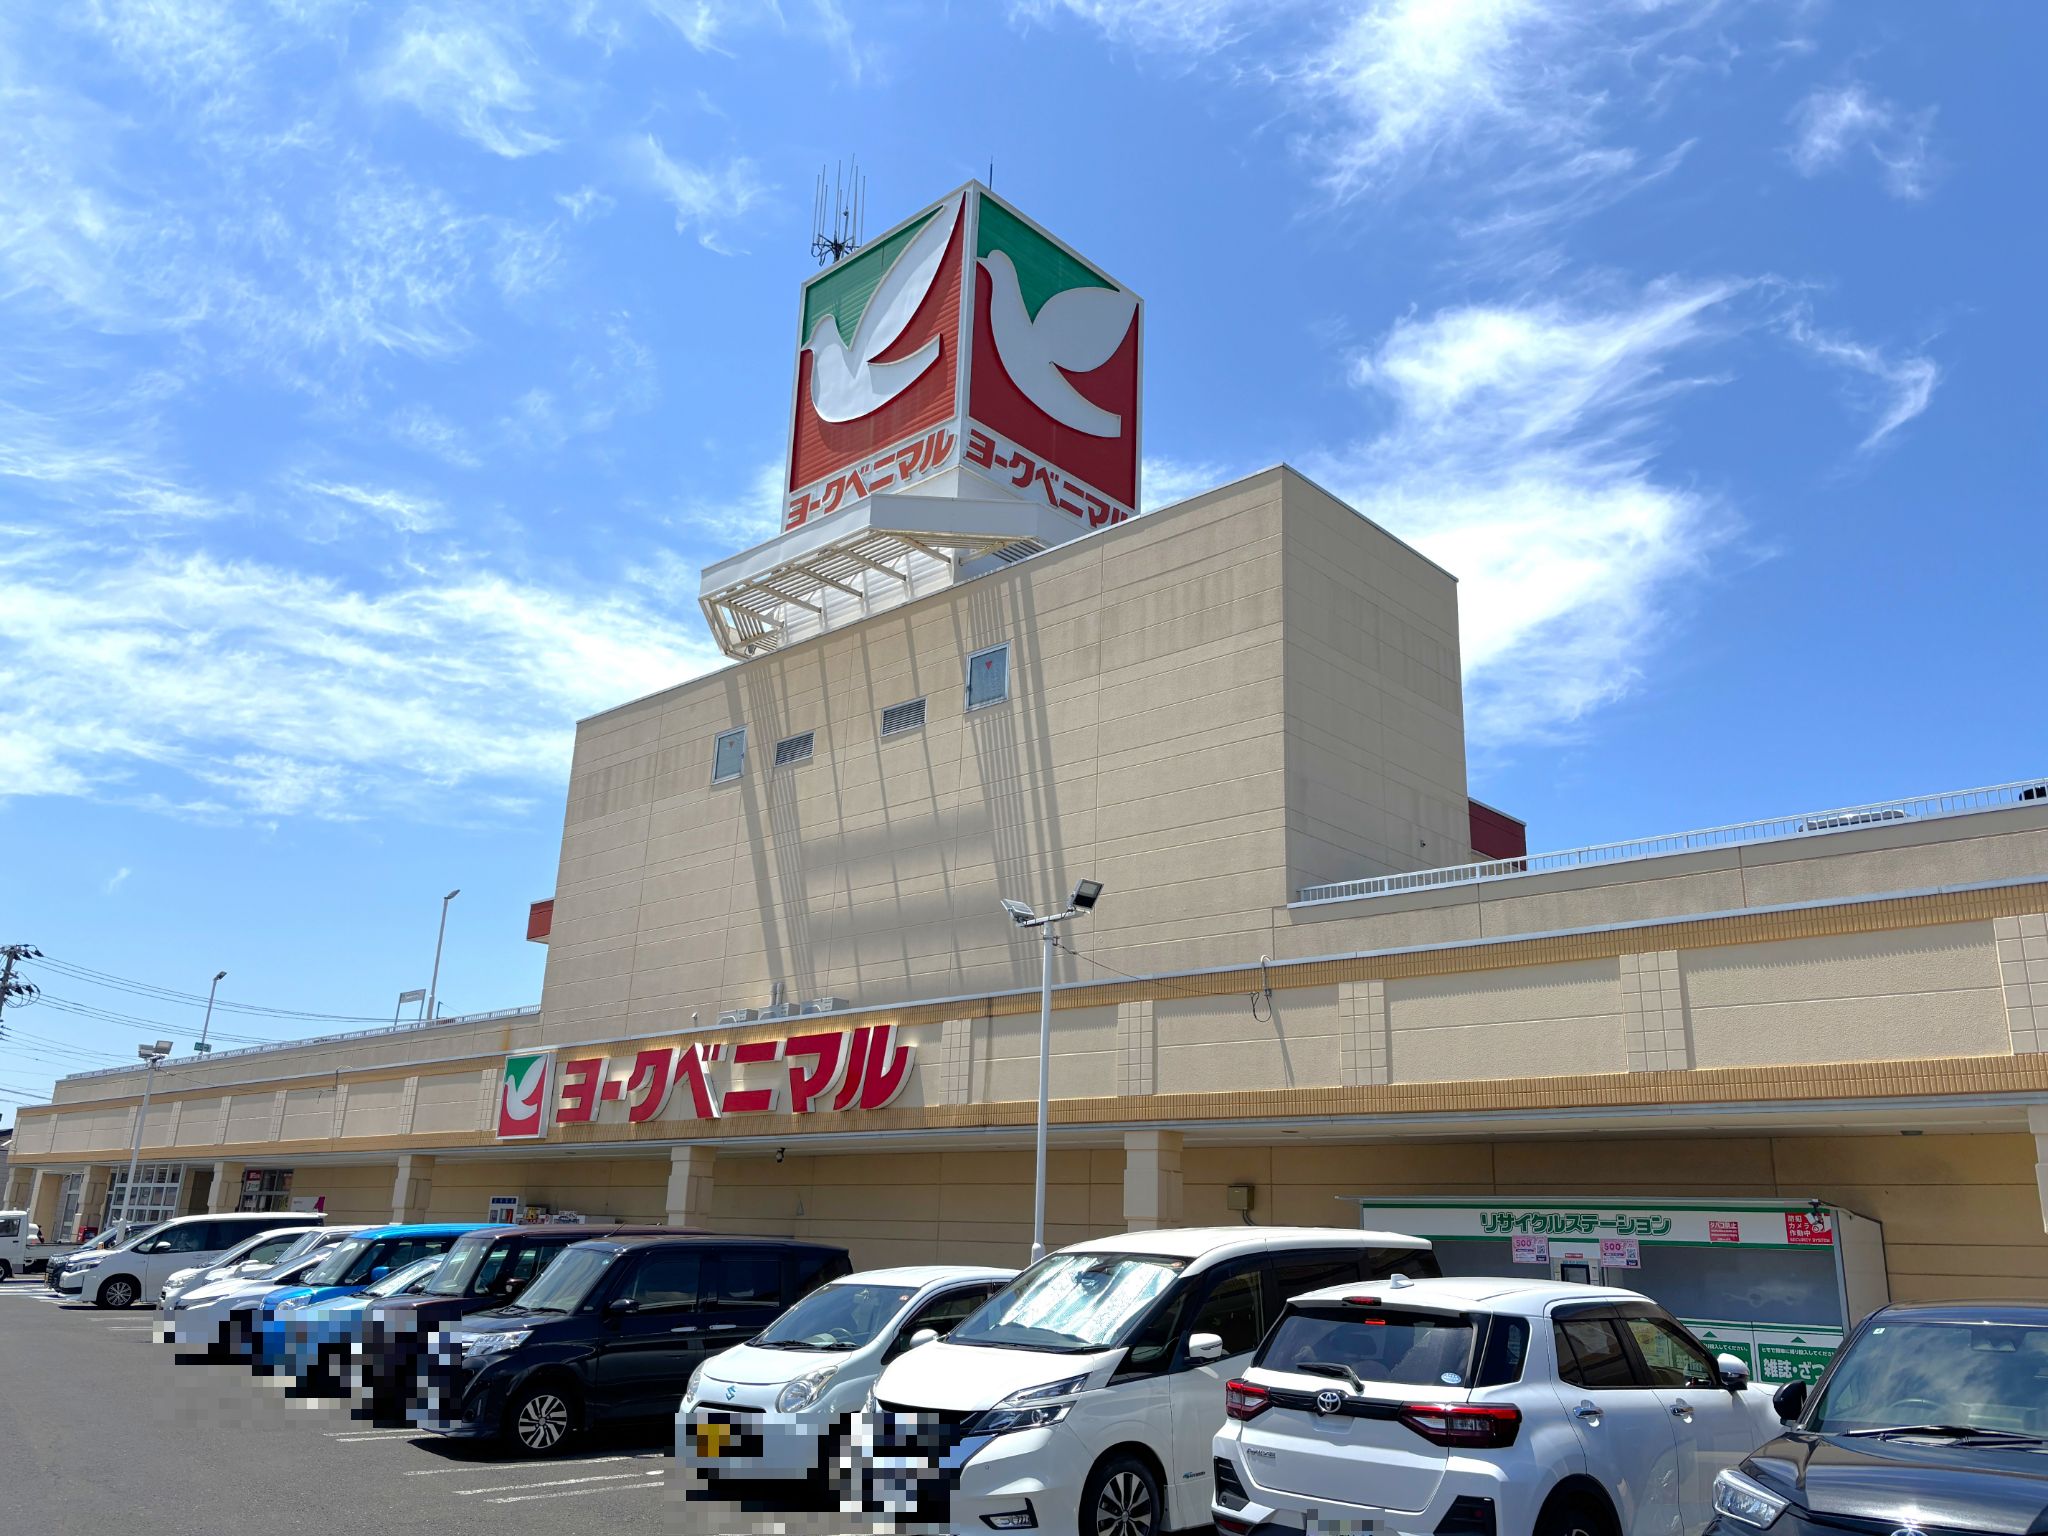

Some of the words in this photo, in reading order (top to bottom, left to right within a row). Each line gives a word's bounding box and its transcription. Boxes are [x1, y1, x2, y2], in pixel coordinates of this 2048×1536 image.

[785, 428, 957, 531] ヨークベニマル
[963, 428, 1129, 529] ヨークベニマ
[555, 1024, 915, 1124] ヨークベニマル
[1480, 1211, 1672, 1236] リサイクルステーション
[1788, 1222, 1810, 1230] カメラ
[1789, 1230, 1811, 1238] 作動中
[1516, 1239, 1532, 1247] 500
[1604, 1242, 1620, 1251] 500
[1703, 1343, 1748, 1352] り投入してください。
